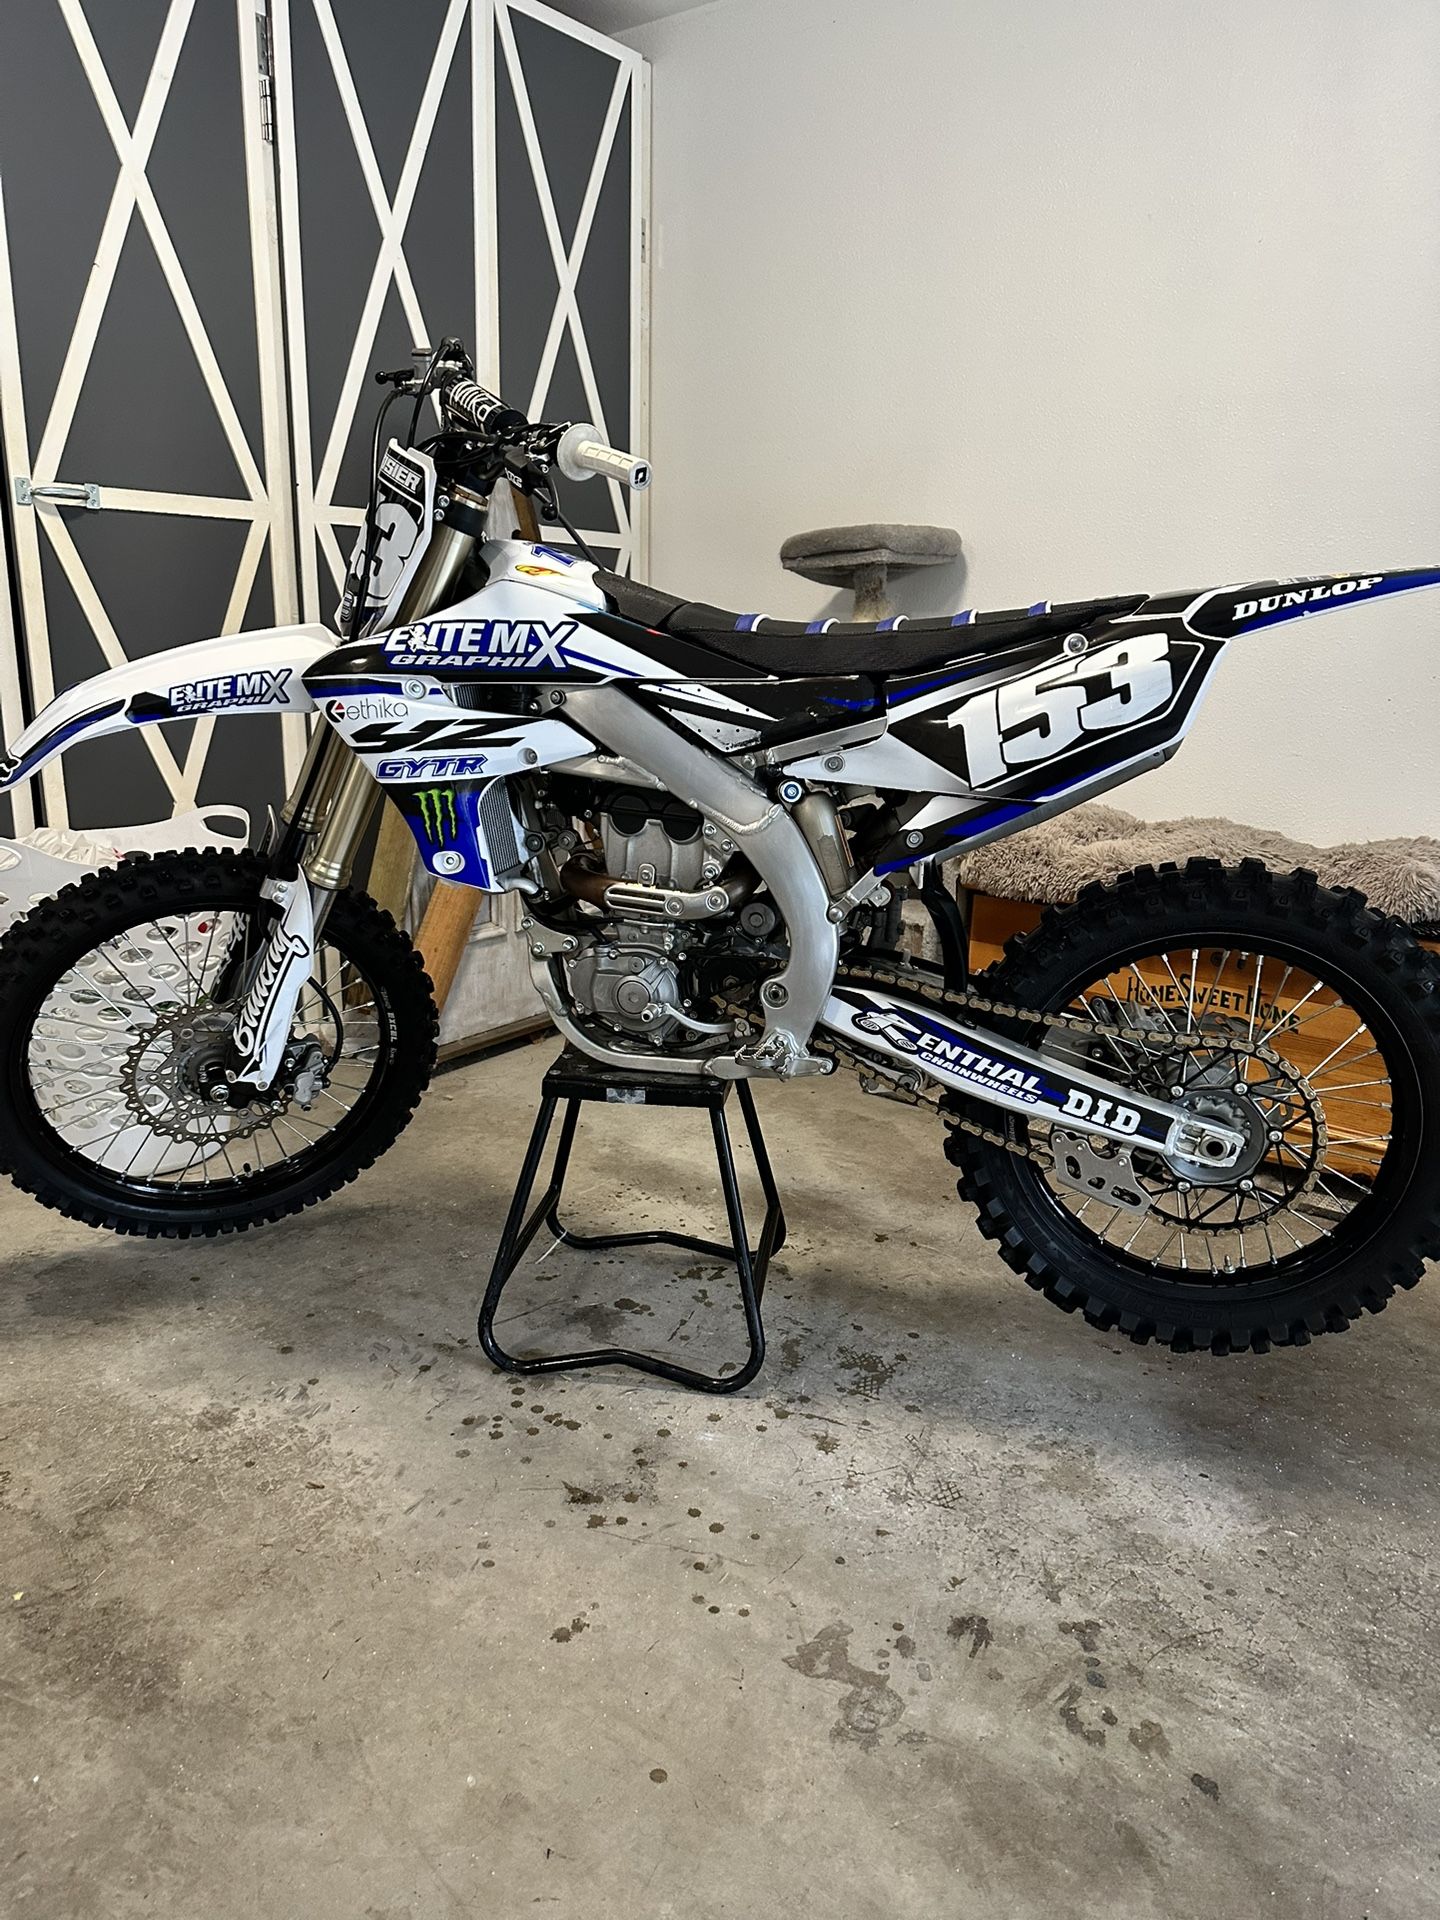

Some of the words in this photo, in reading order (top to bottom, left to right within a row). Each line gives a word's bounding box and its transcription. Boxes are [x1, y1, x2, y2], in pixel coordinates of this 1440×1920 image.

[383, 456, 421, 490] SIER
[1232, 576, 1383, 620] DUNLOP
[346, 698, 409, 721] ethika
[948, 633, 1173, 789] 153
[376, 754, 488, 779] GYTR
[919, 1051, 1038, 1104] CHAINWHEELS
